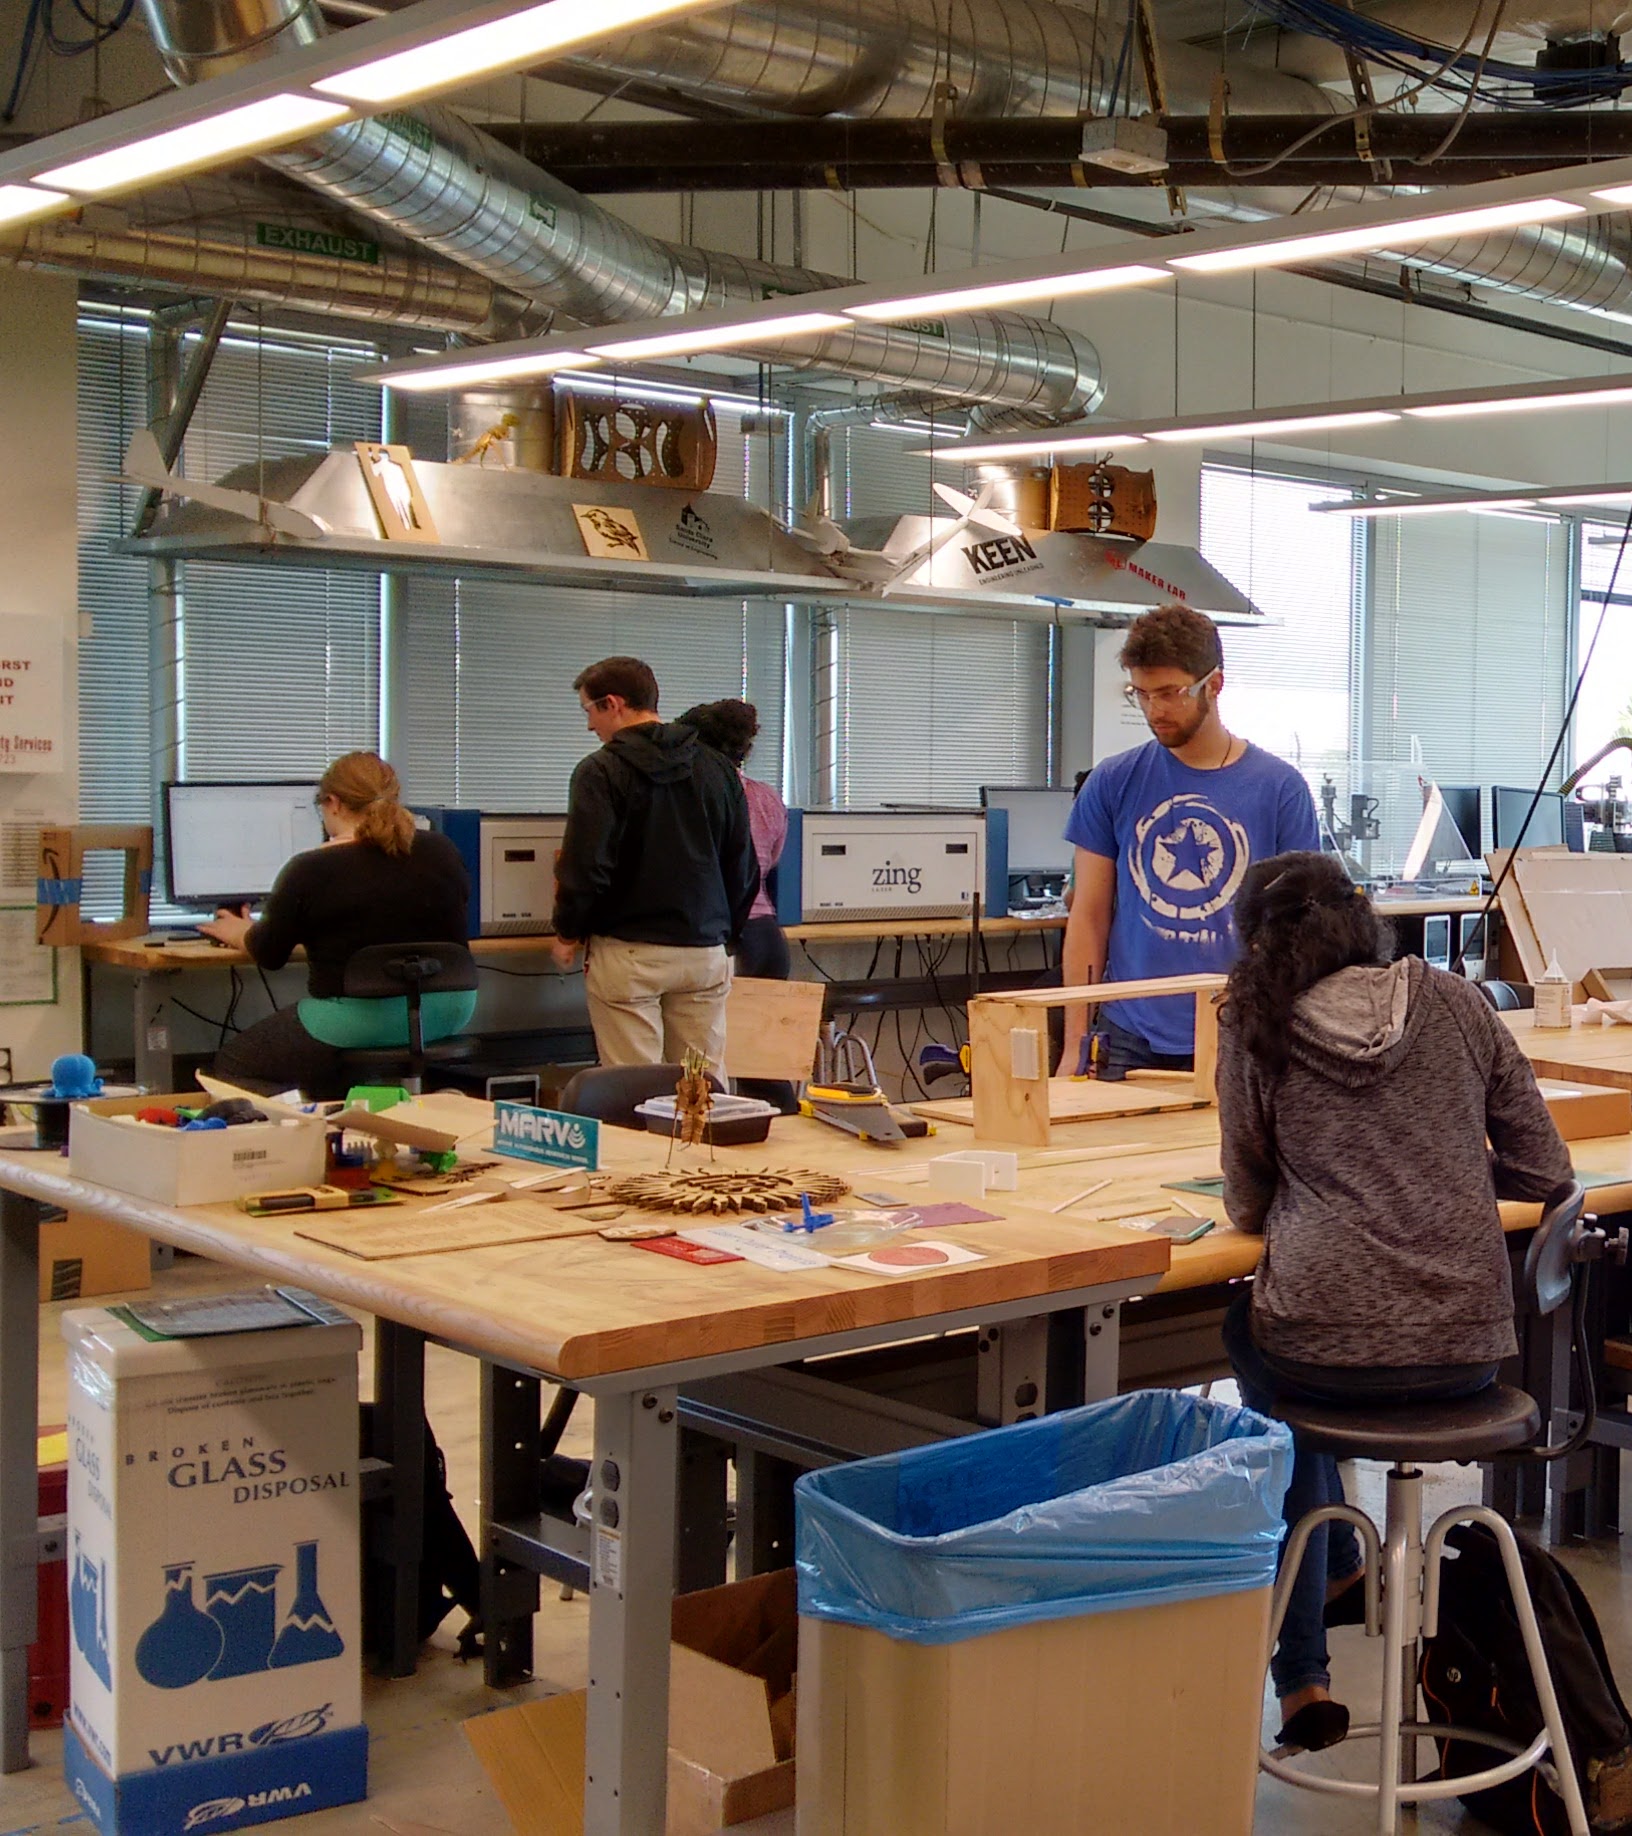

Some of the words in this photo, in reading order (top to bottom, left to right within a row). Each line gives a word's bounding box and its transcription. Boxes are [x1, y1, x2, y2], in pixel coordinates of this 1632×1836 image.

[265, 226, 369, 259] EXHAUST
[893, 319, 939, 335] AUST
[676, 524, 694, 536] Santa
[696, 531, 713, 543] Clara
[678, 531, 710, 549] University
[961, 535, 1037, 574] KEEN
[1129, 562, 1165, 589] MAKER
[1167, 583, 1186, 600] LAB
[0, 660, 31, 670] RST
[14, 736, 52, 751] Services
[872, 860, 922, 894] zing
[125, 1437, 254, 1466] BROKEN
[168, 1450, 287, 1488] GLASS
[234, 1472, 350, 1504] DISPOSAL
[148, 1733, 243, 1766] VWR
[248, 1783, 311, 1807] VWR
